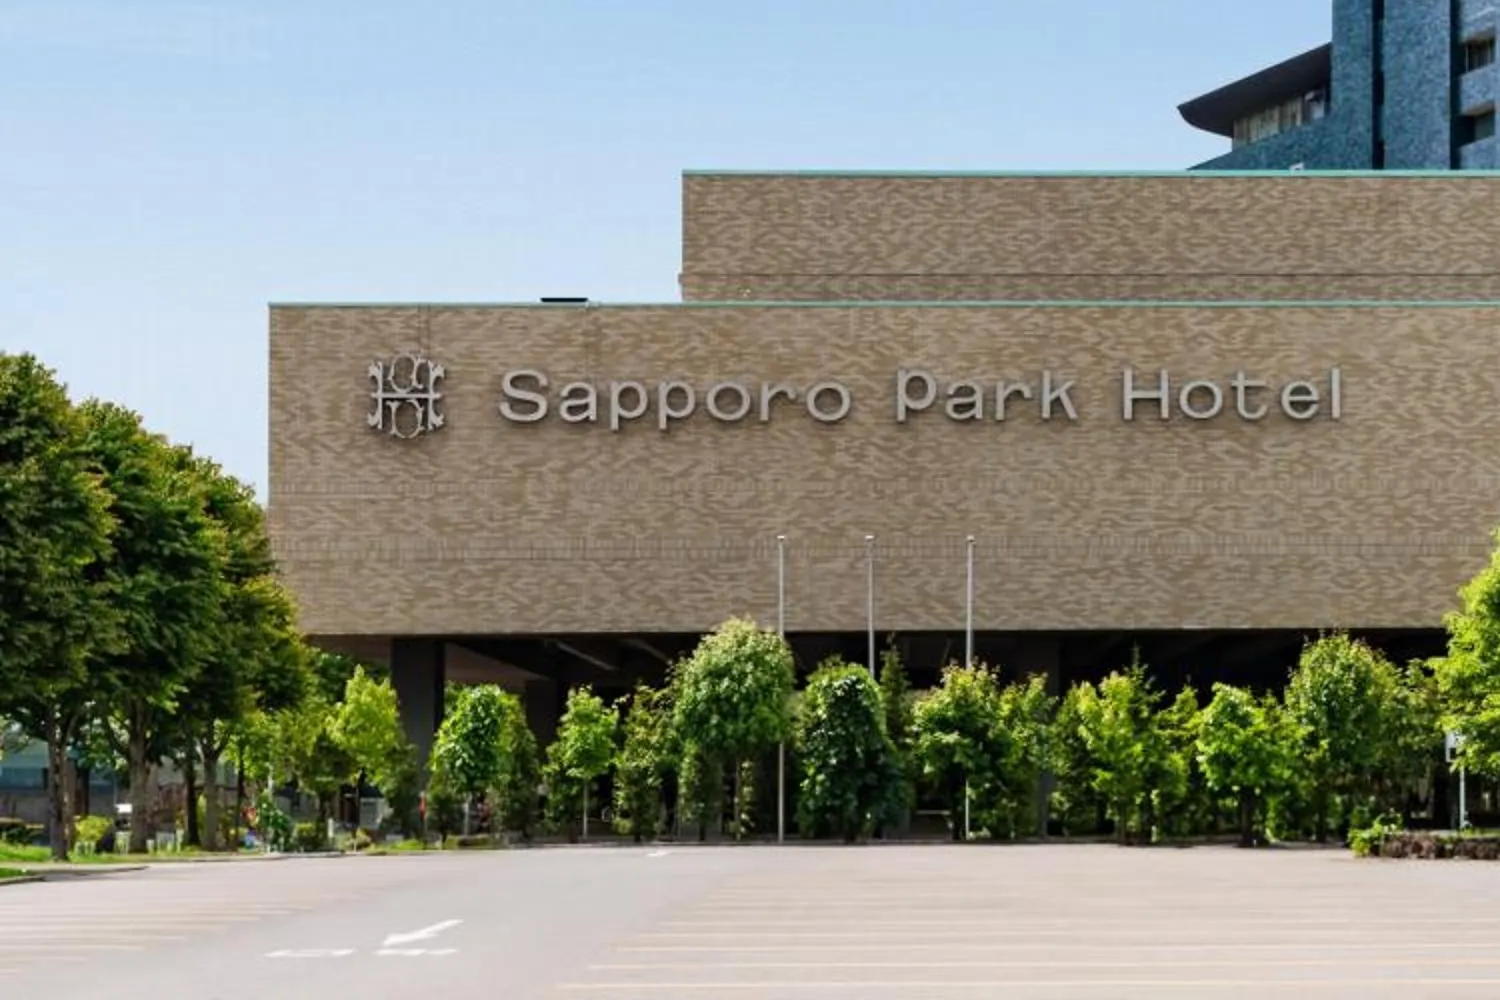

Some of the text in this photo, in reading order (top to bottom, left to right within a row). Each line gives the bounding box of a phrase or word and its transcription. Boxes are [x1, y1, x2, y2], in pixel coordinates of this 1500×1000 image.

[501, 367, 1342, 429] Sapporo Park Hotel
